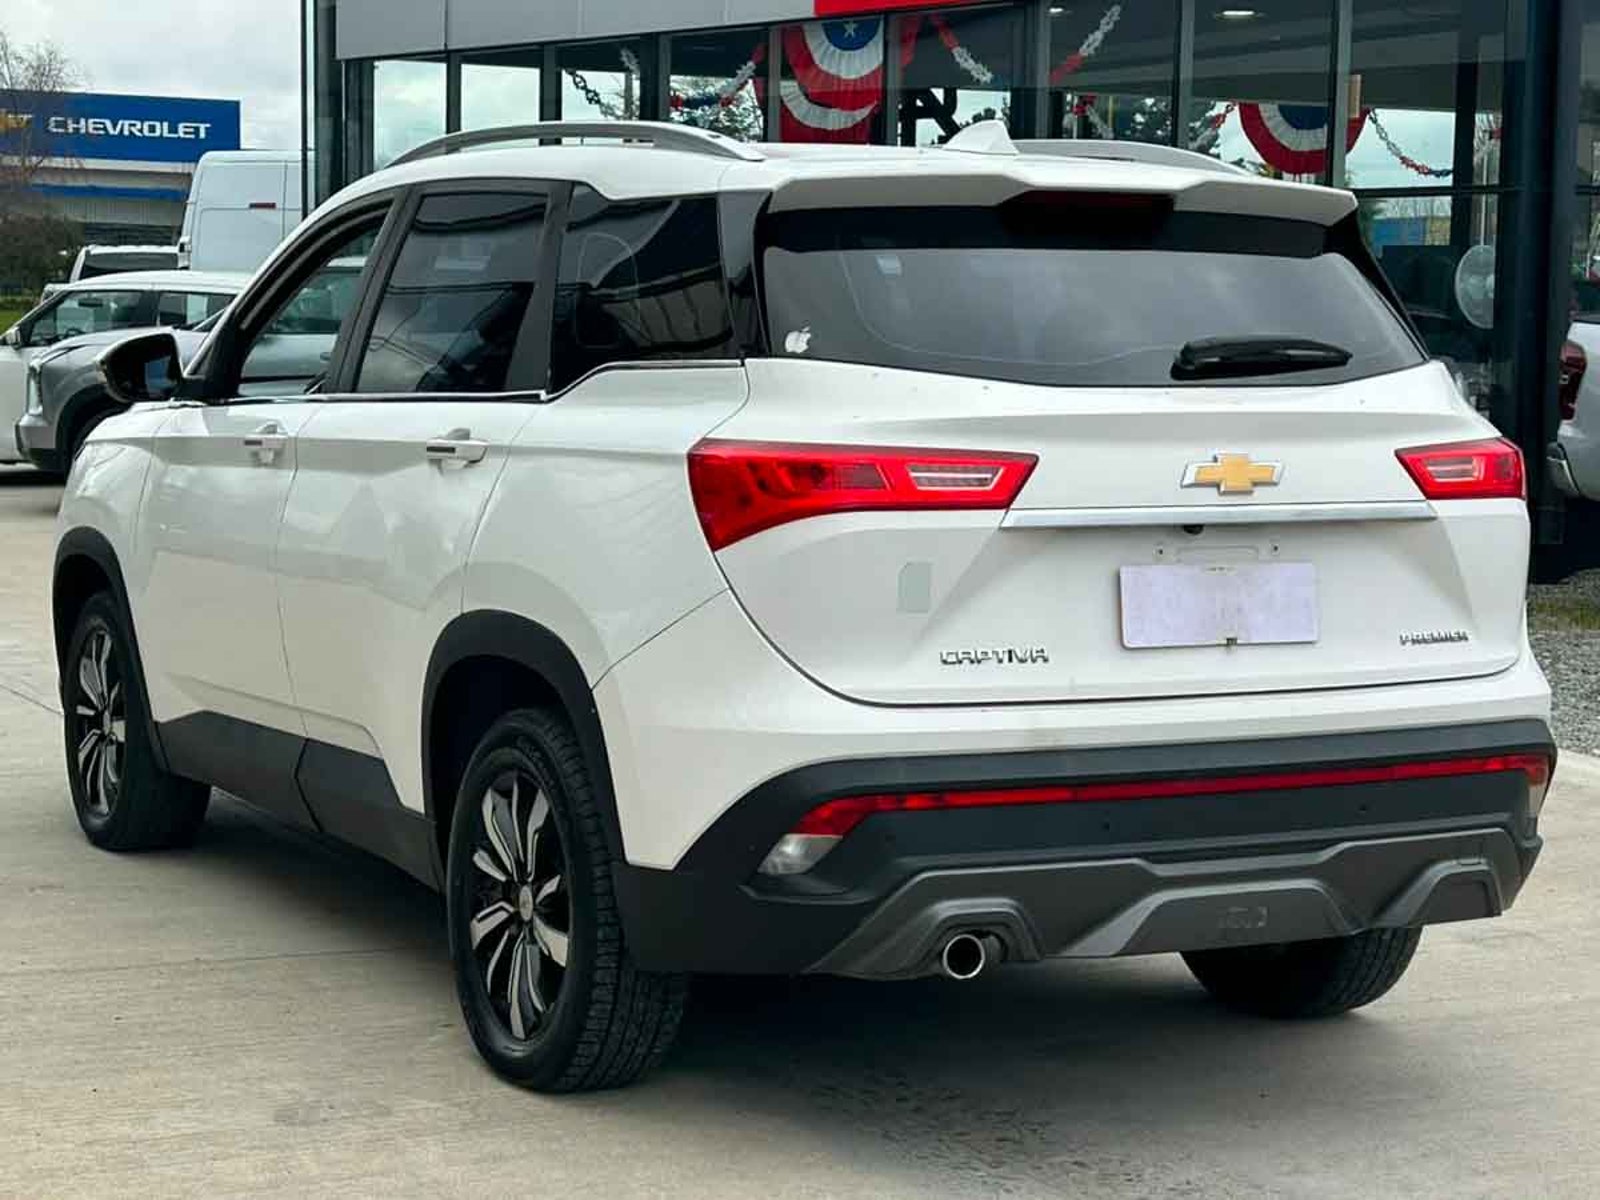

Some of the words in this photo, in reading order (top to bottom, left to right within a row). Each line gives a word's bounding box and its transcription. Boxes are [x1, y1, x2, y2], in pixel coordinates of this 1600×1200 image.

[48, 115, 211, 139] CHEVROLET
[1399, 630, 1469, 645] PREMIER
[940, 648, 1050, 665] CAPTIVA
